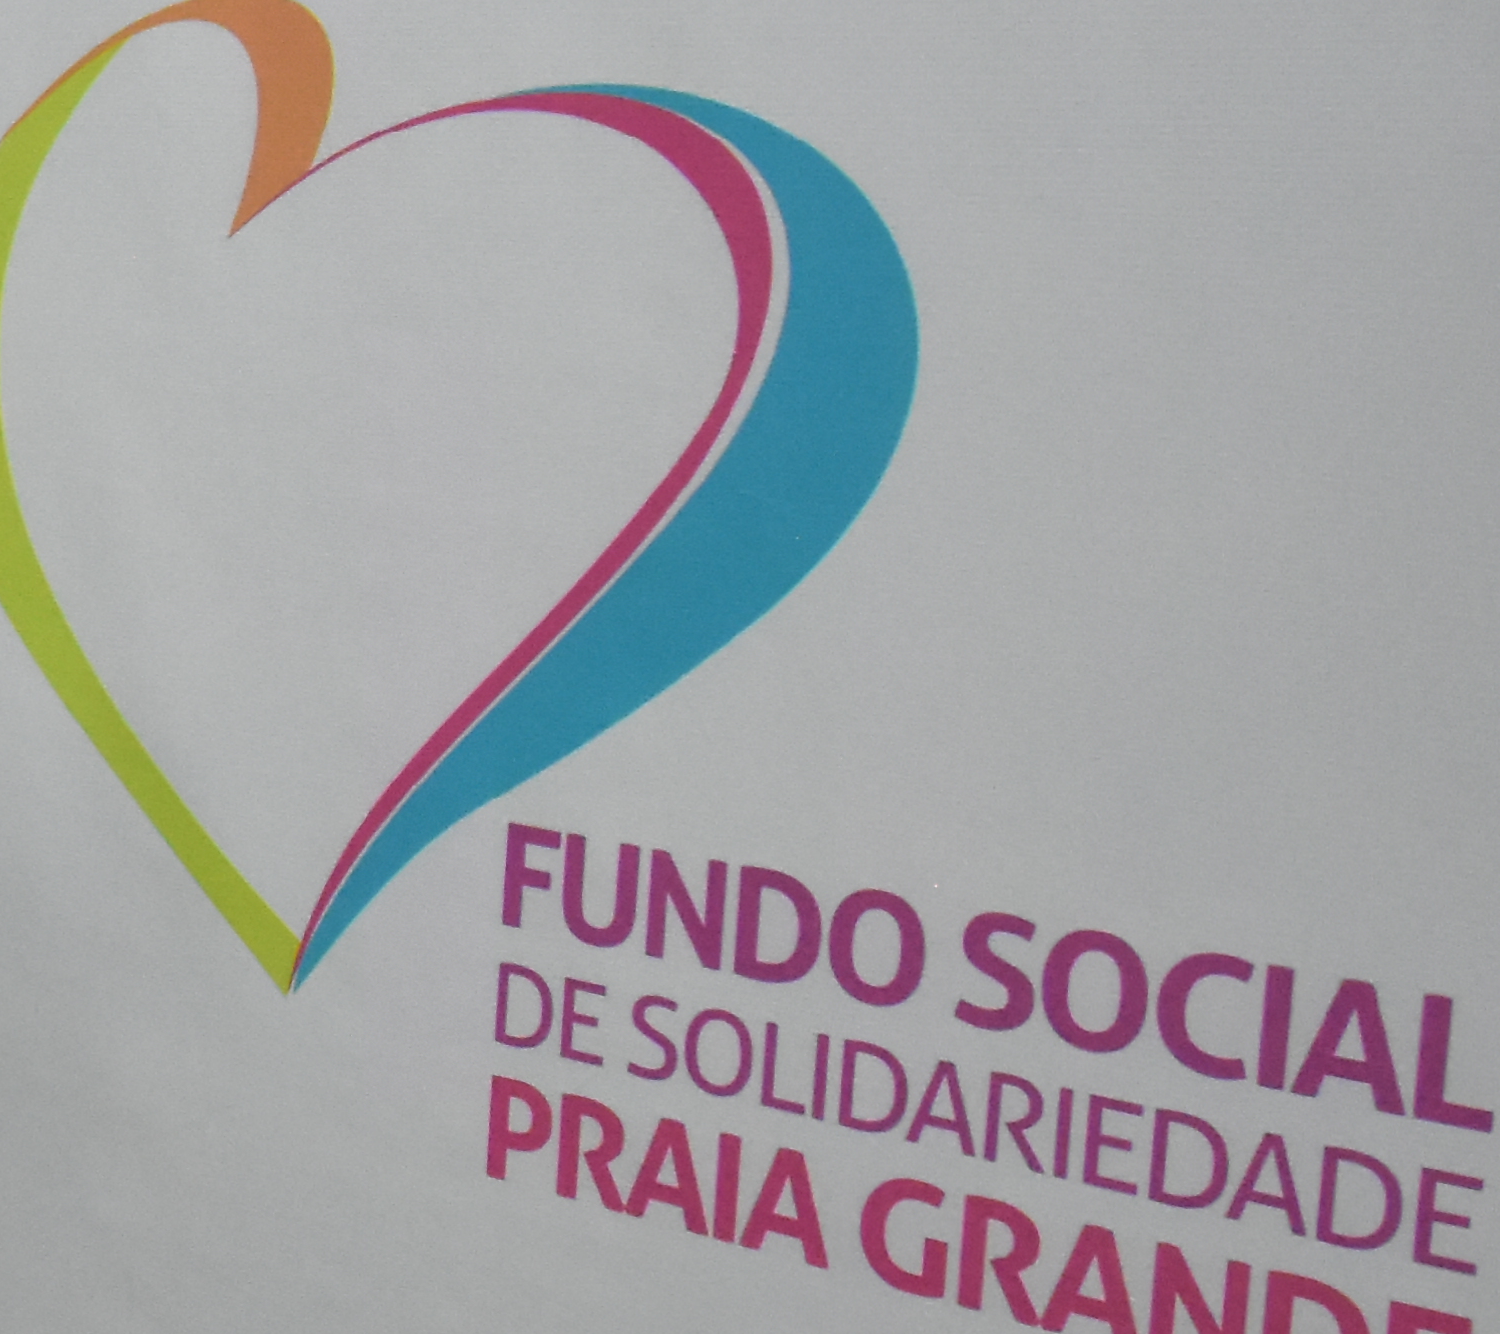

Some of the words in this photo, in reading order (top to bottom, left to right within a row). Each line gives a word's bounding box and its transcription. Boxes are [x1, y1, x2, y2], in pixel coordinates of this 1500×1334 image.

[494, 961, 609, 1067] DE
[626, 993, 1485, 1276] SOLIDARIEDADE
[500, 822, 927, 1007] FUNDO
[953, 910, 1496, 1134] SOCIAL
[485, 1074, 829, 1271] PRAIA
